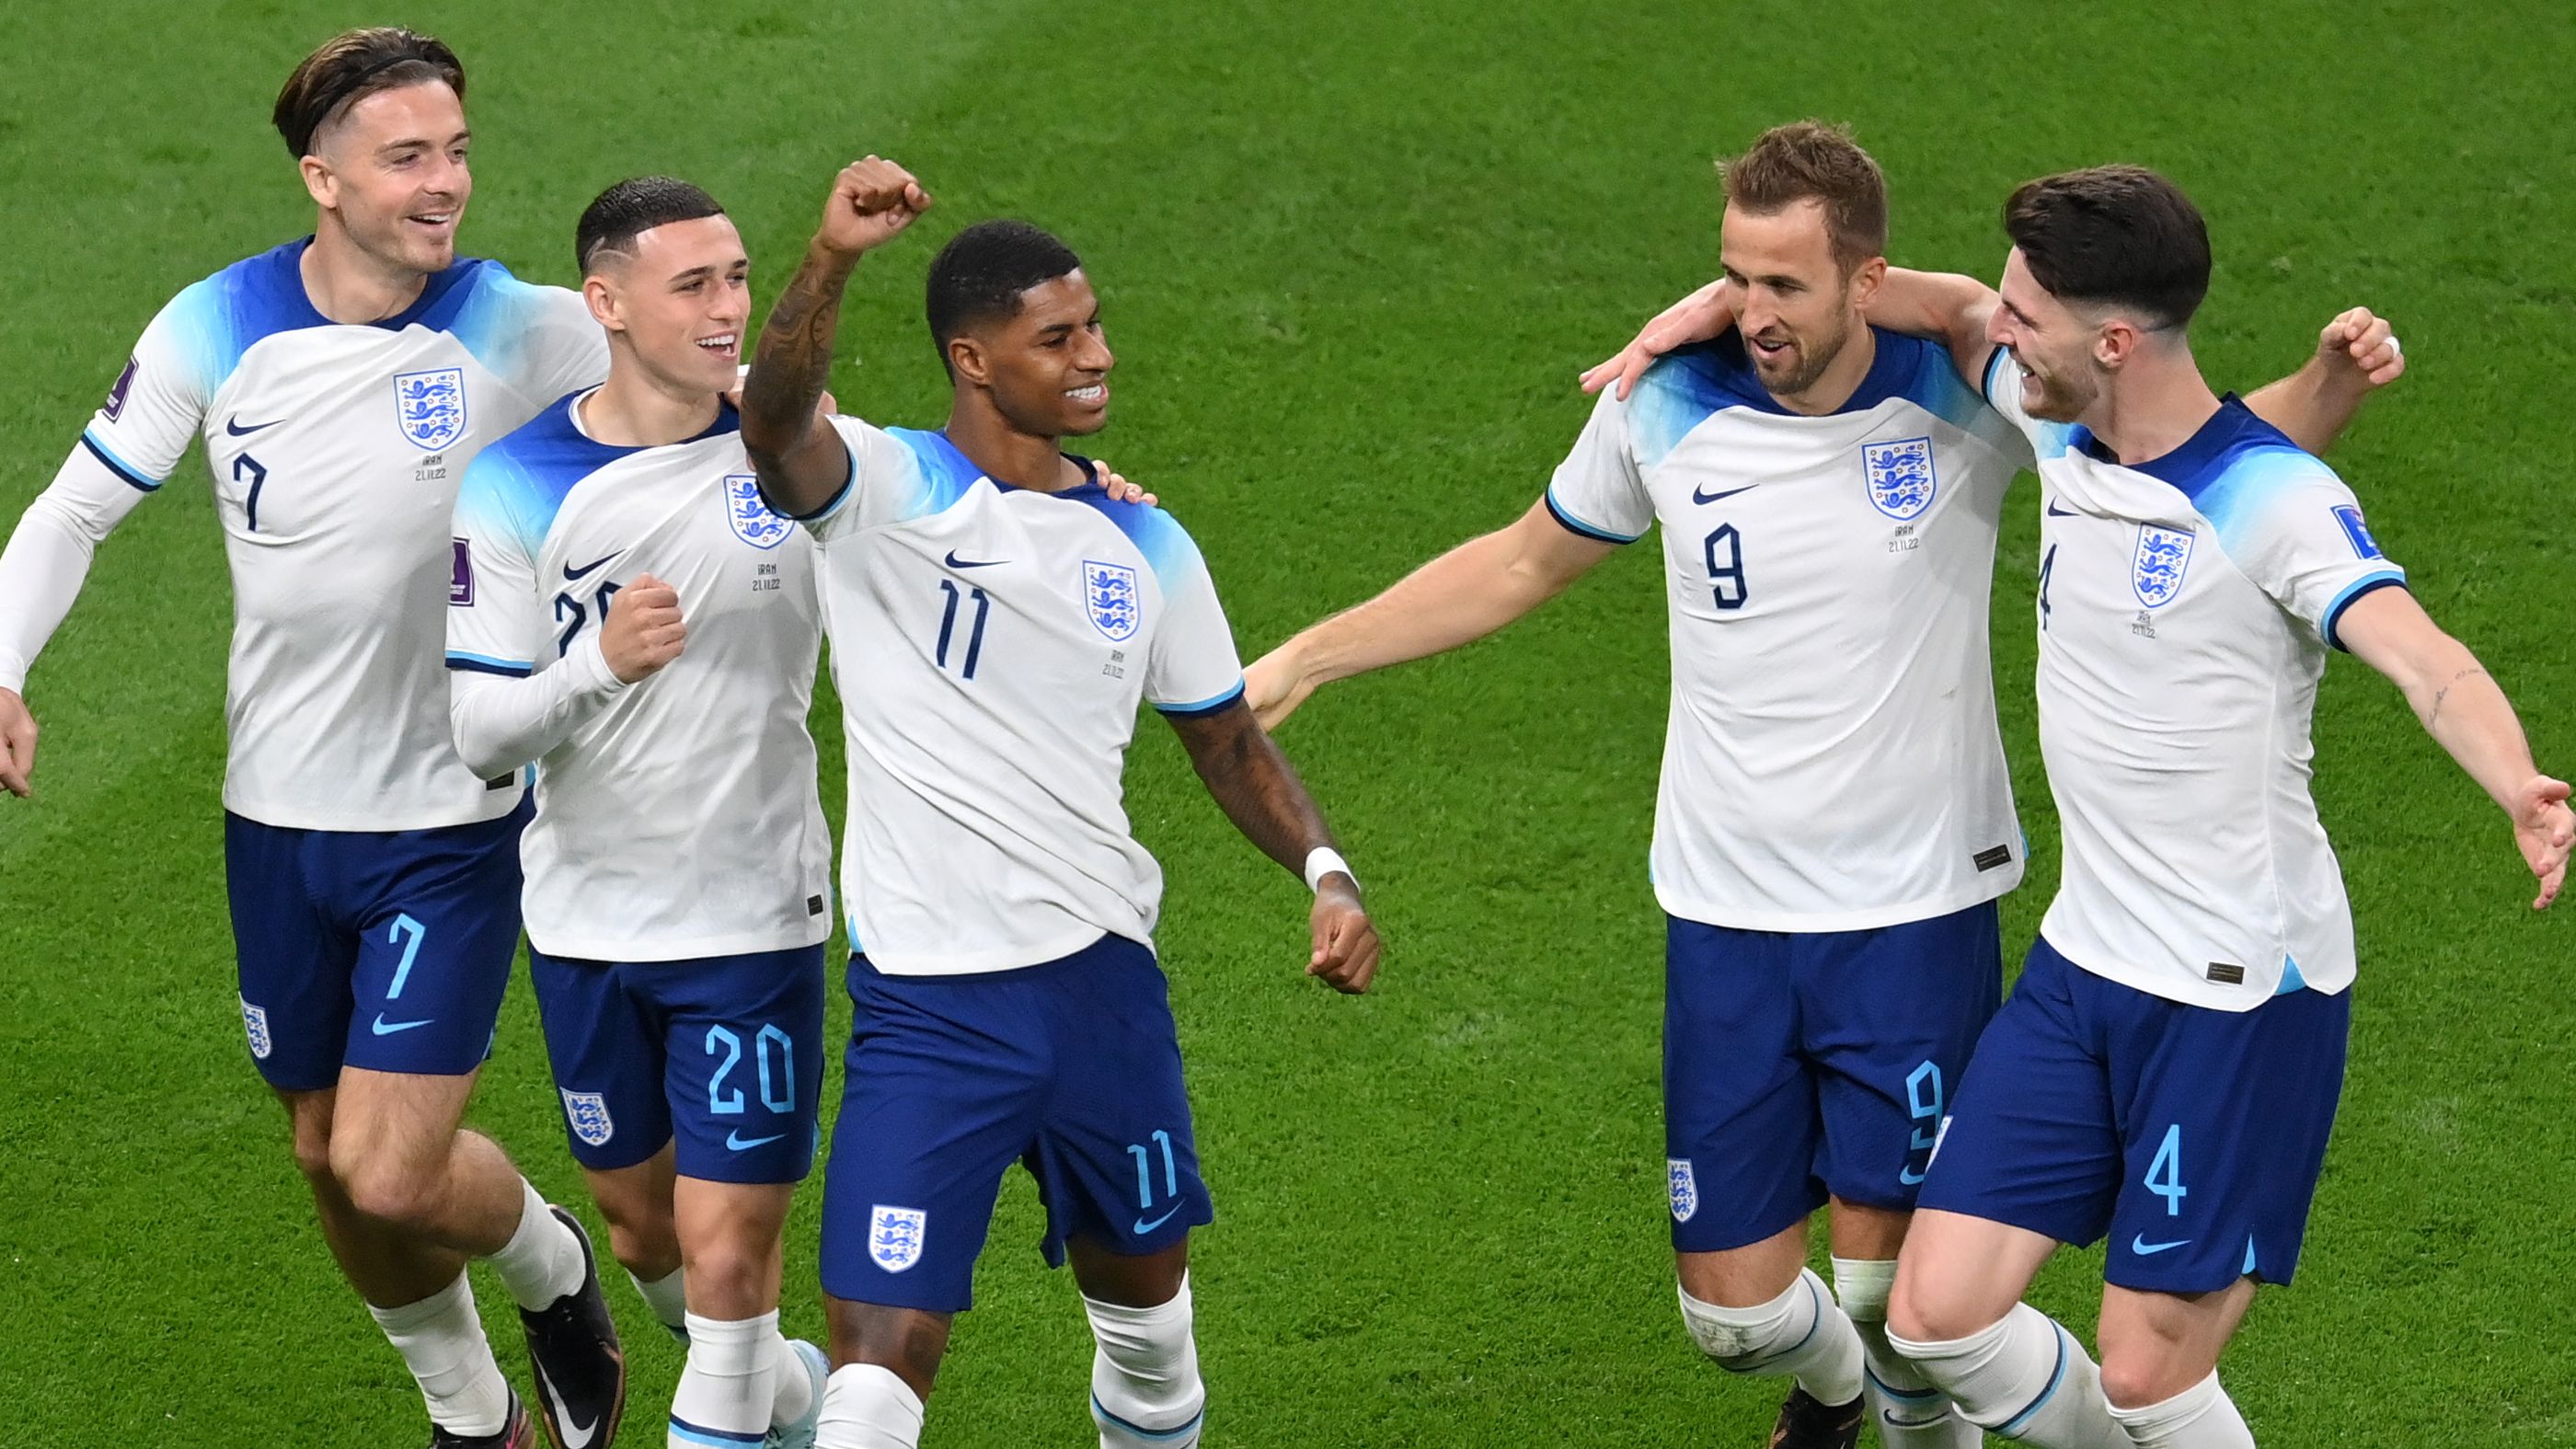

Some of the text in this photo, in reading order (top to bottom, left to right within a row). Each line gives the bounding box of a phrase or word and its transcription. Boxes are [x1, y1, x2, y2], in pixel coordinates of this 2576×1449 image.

[234, 453, 267, 532] 7
[1704, 523, 1748, 610] 9
[554, 581, 623, 659] 2
[936, 579, 989, 679] 11
[386, 913, 426, 1000] 7
[705, 1023, 797, 1114] 20
[1905, 1059, 1943, 1151] 9
[1127, 1129, 1177, 1209] 11
[2143, 1123, 2187, 1216] 4
